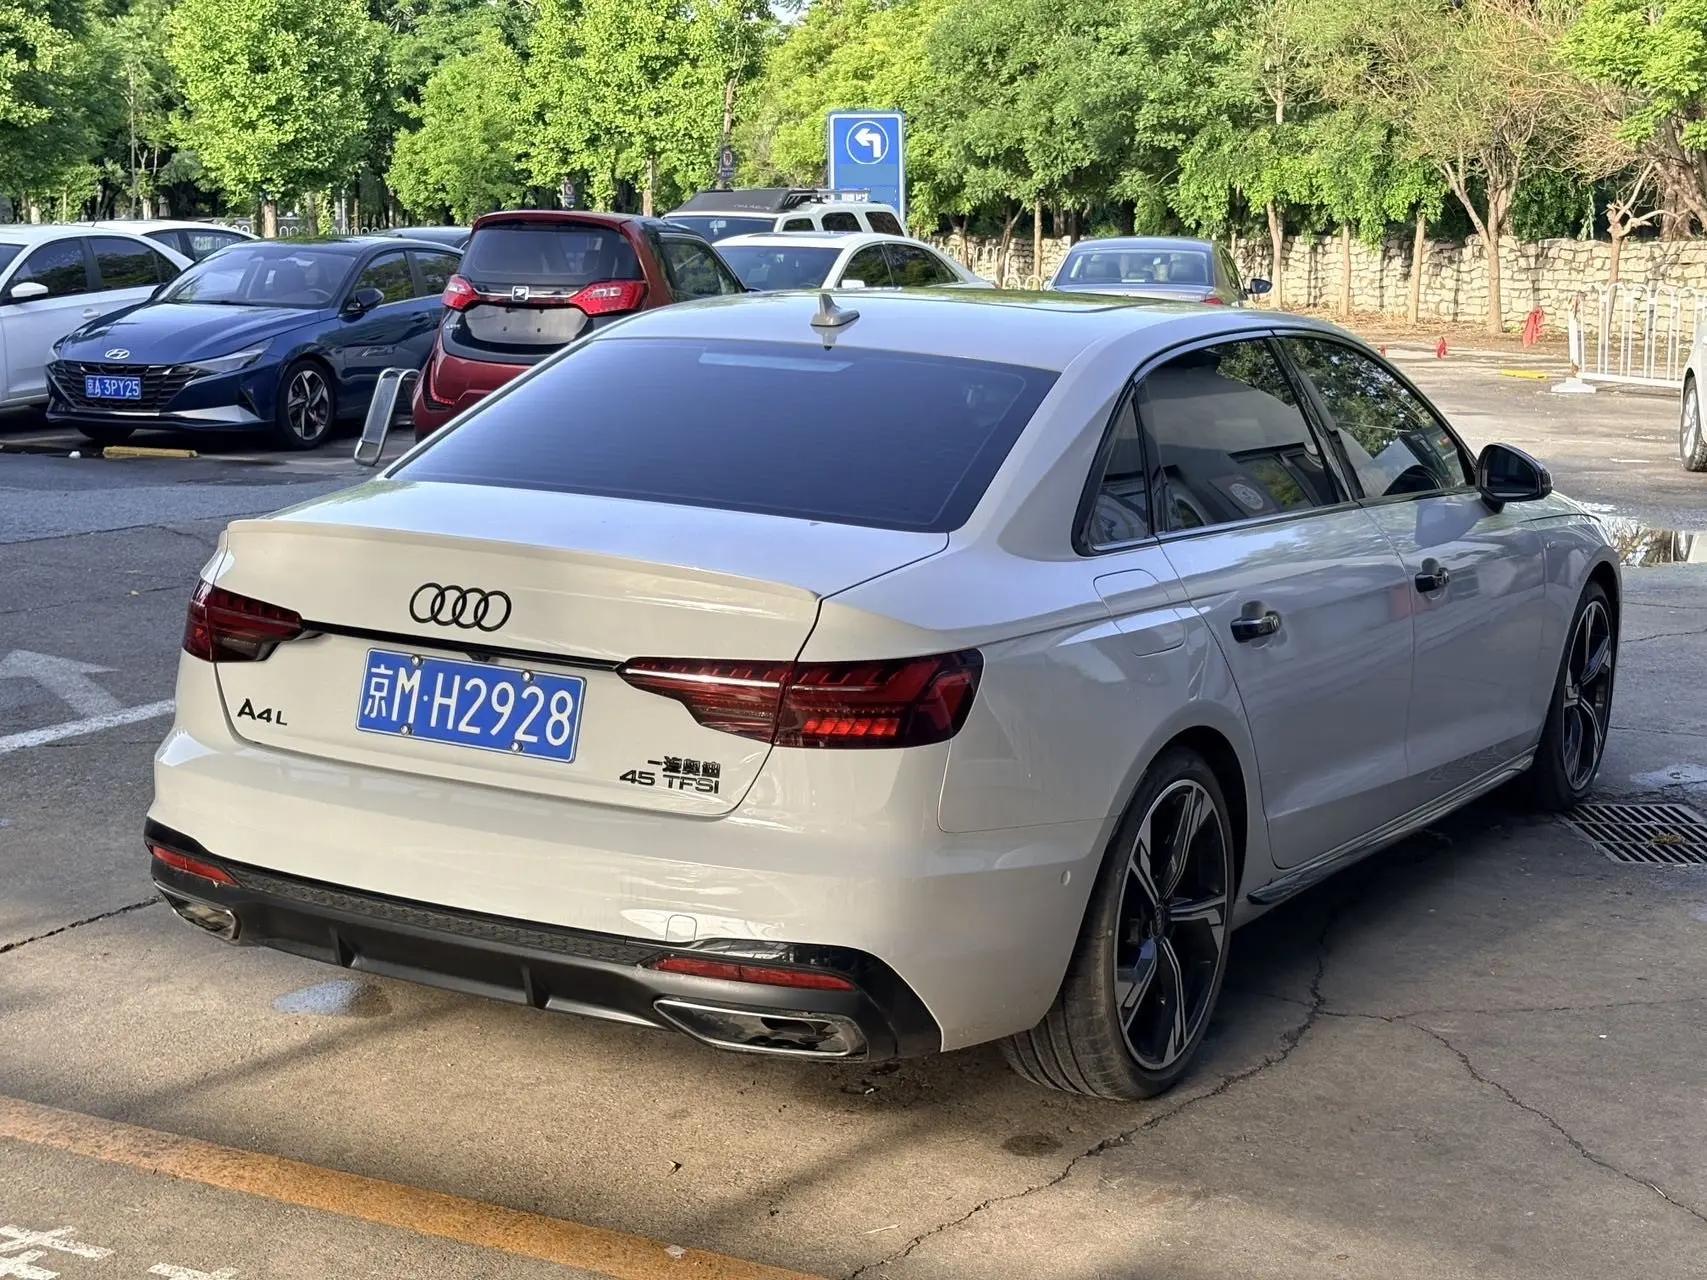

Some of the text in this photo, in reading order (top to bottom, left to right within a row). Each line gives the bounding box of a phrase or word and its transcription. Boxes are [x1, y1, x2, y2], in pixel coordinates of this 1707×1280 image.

[237, 697, 288, 727] A4L
[364, 663, 574, 747] 京M·H2928
[619, 769, 720, 794] 45 TFSI
